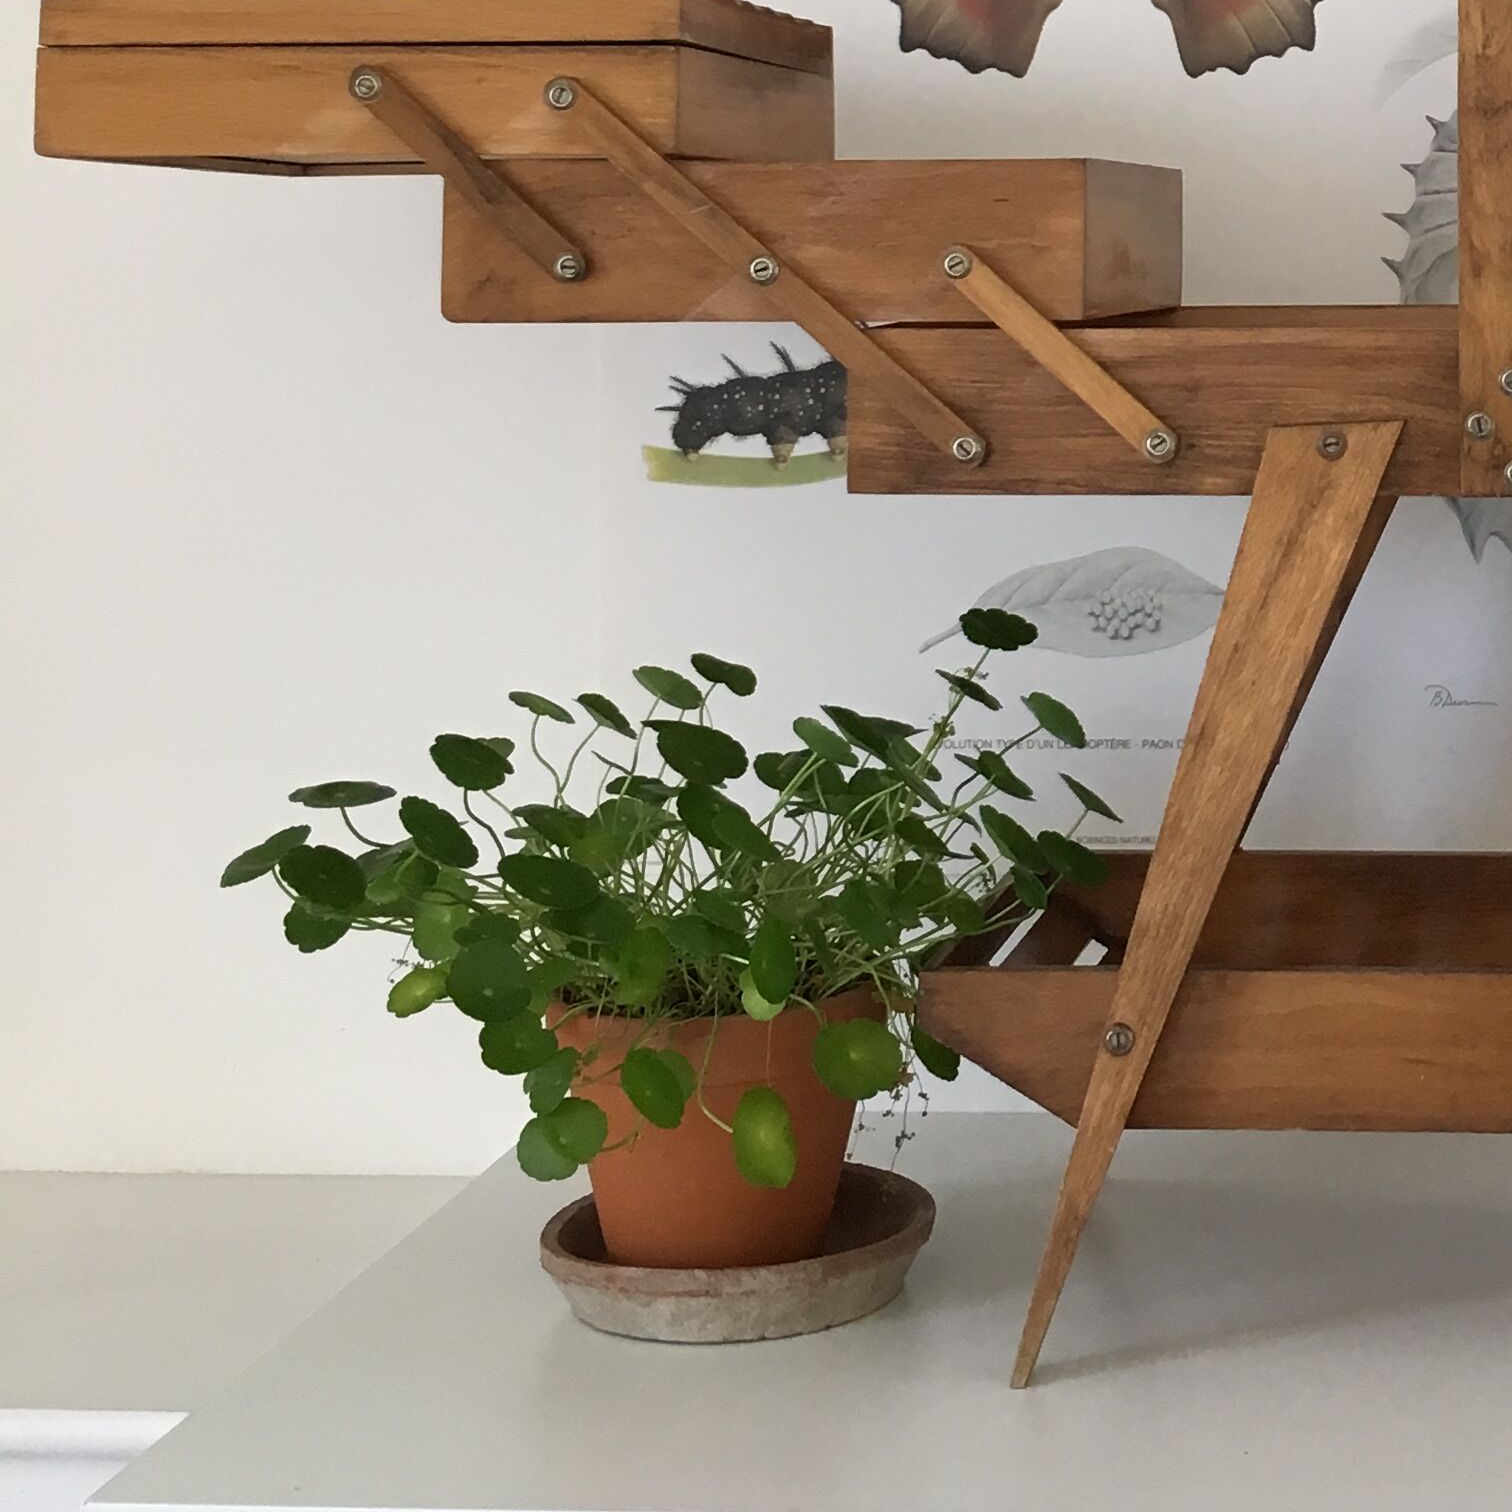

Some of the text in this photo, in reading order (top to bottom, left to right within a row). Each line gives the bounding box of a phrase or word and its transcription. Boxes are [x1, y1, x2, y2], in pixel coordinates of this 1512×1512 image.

[942, 738, 993, 750] OLUTION
[1027, 738, 1054, 750] D'UN
[1142, 738, 1174, 750] PAON
